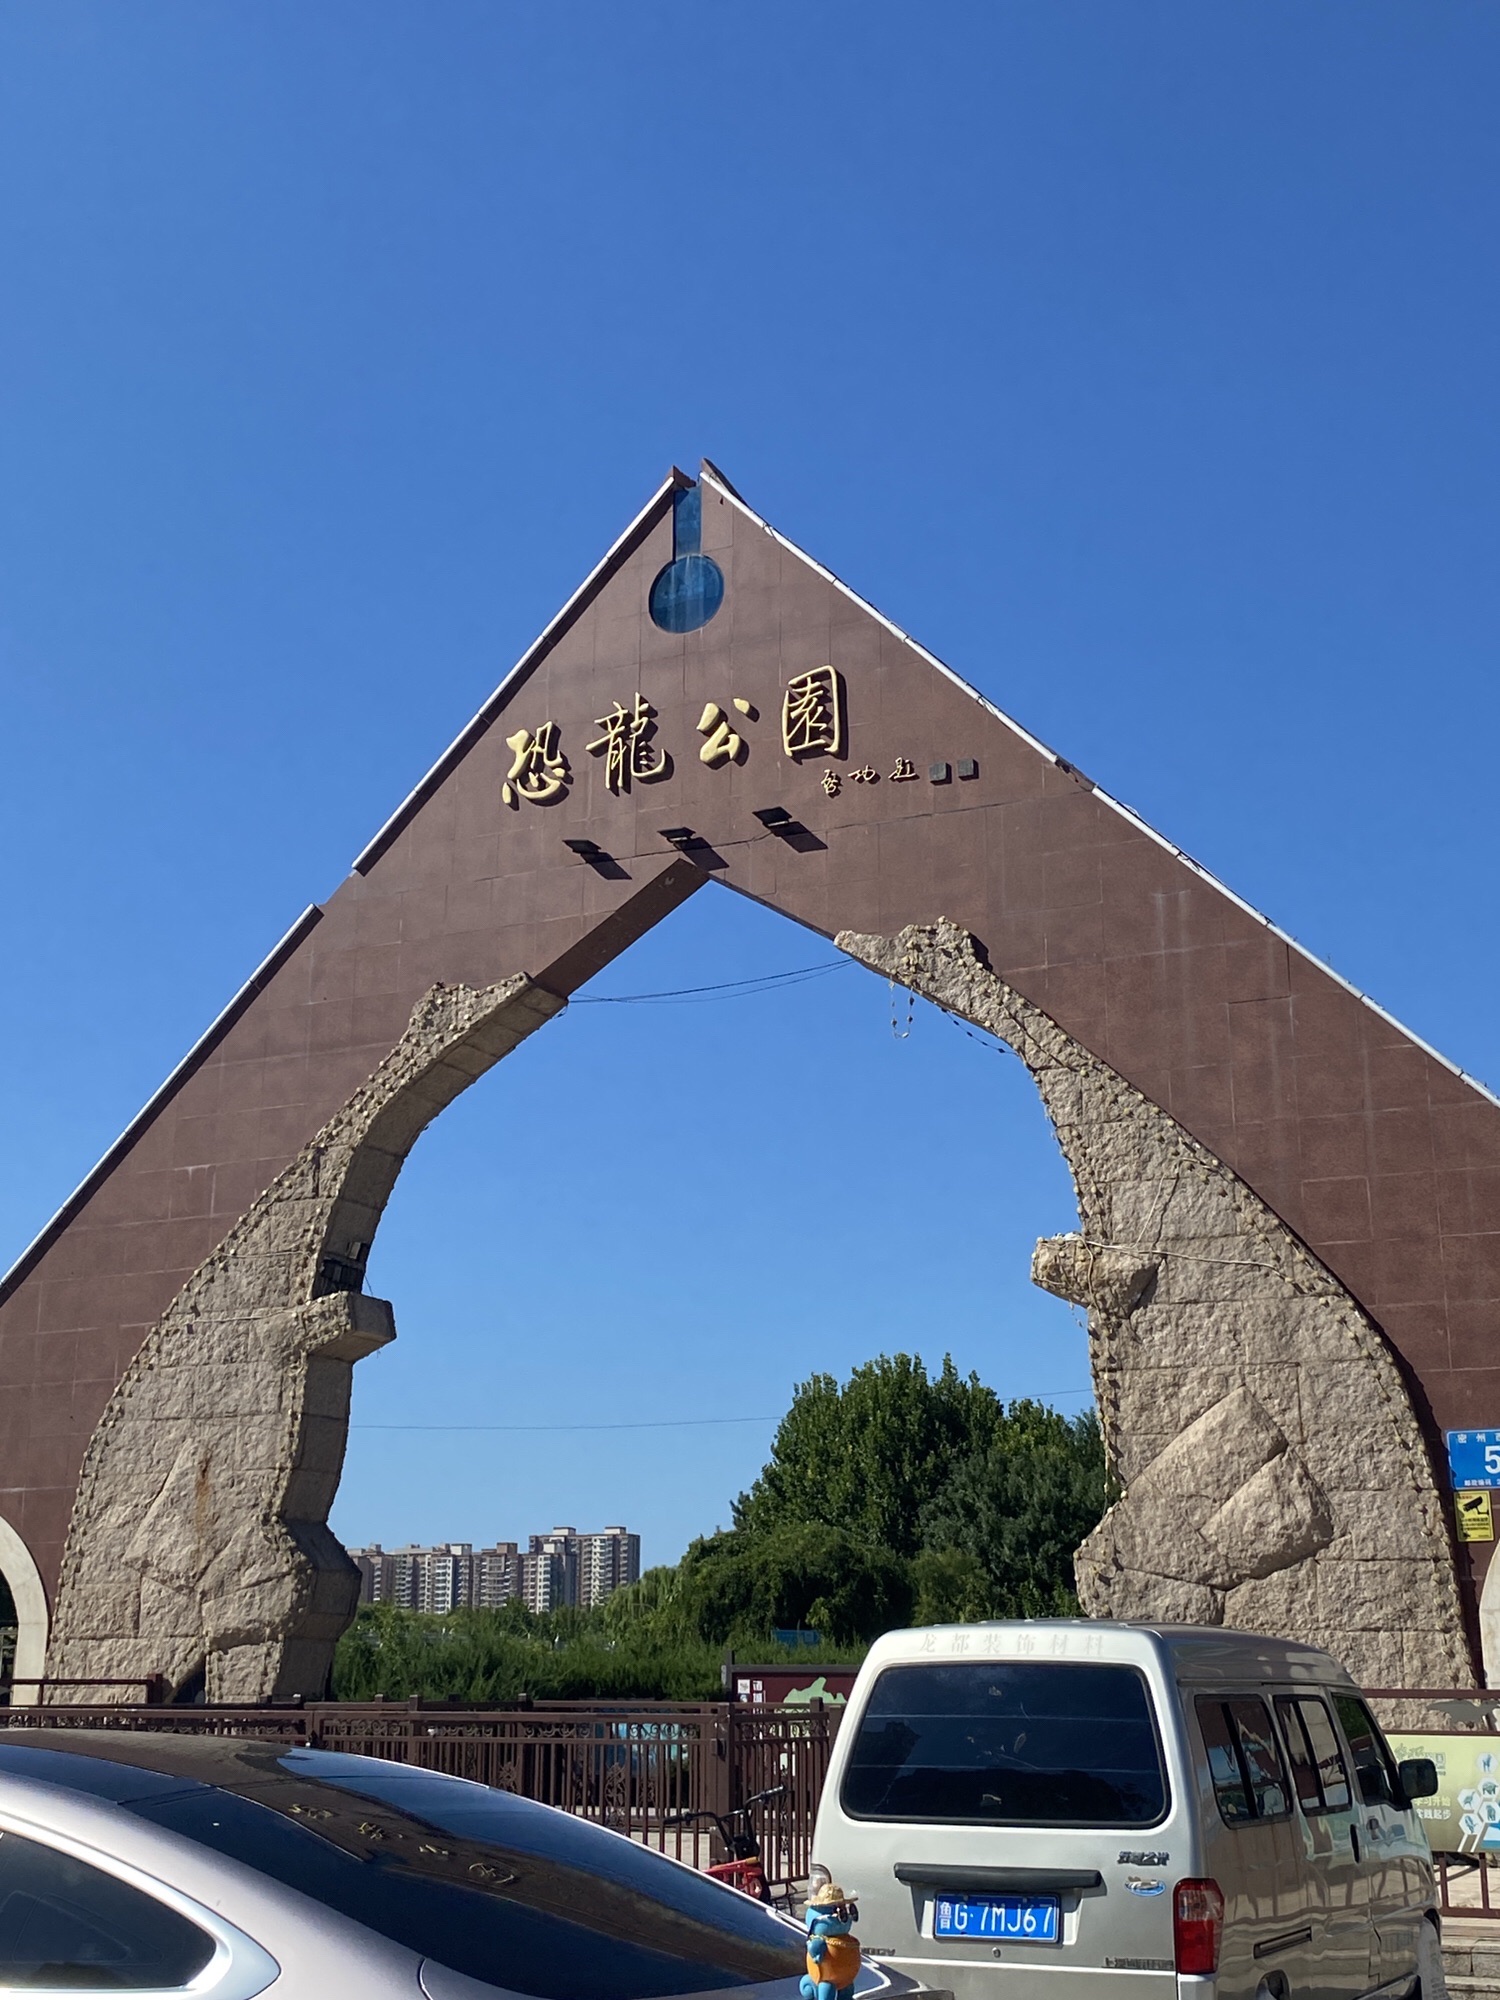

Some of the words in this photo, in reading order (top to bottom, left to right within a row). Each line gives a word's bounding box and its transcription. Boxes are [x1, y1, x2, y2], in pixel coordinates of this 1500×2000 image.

[919, 1632, 1104, 1655] 龙都装饰材料
